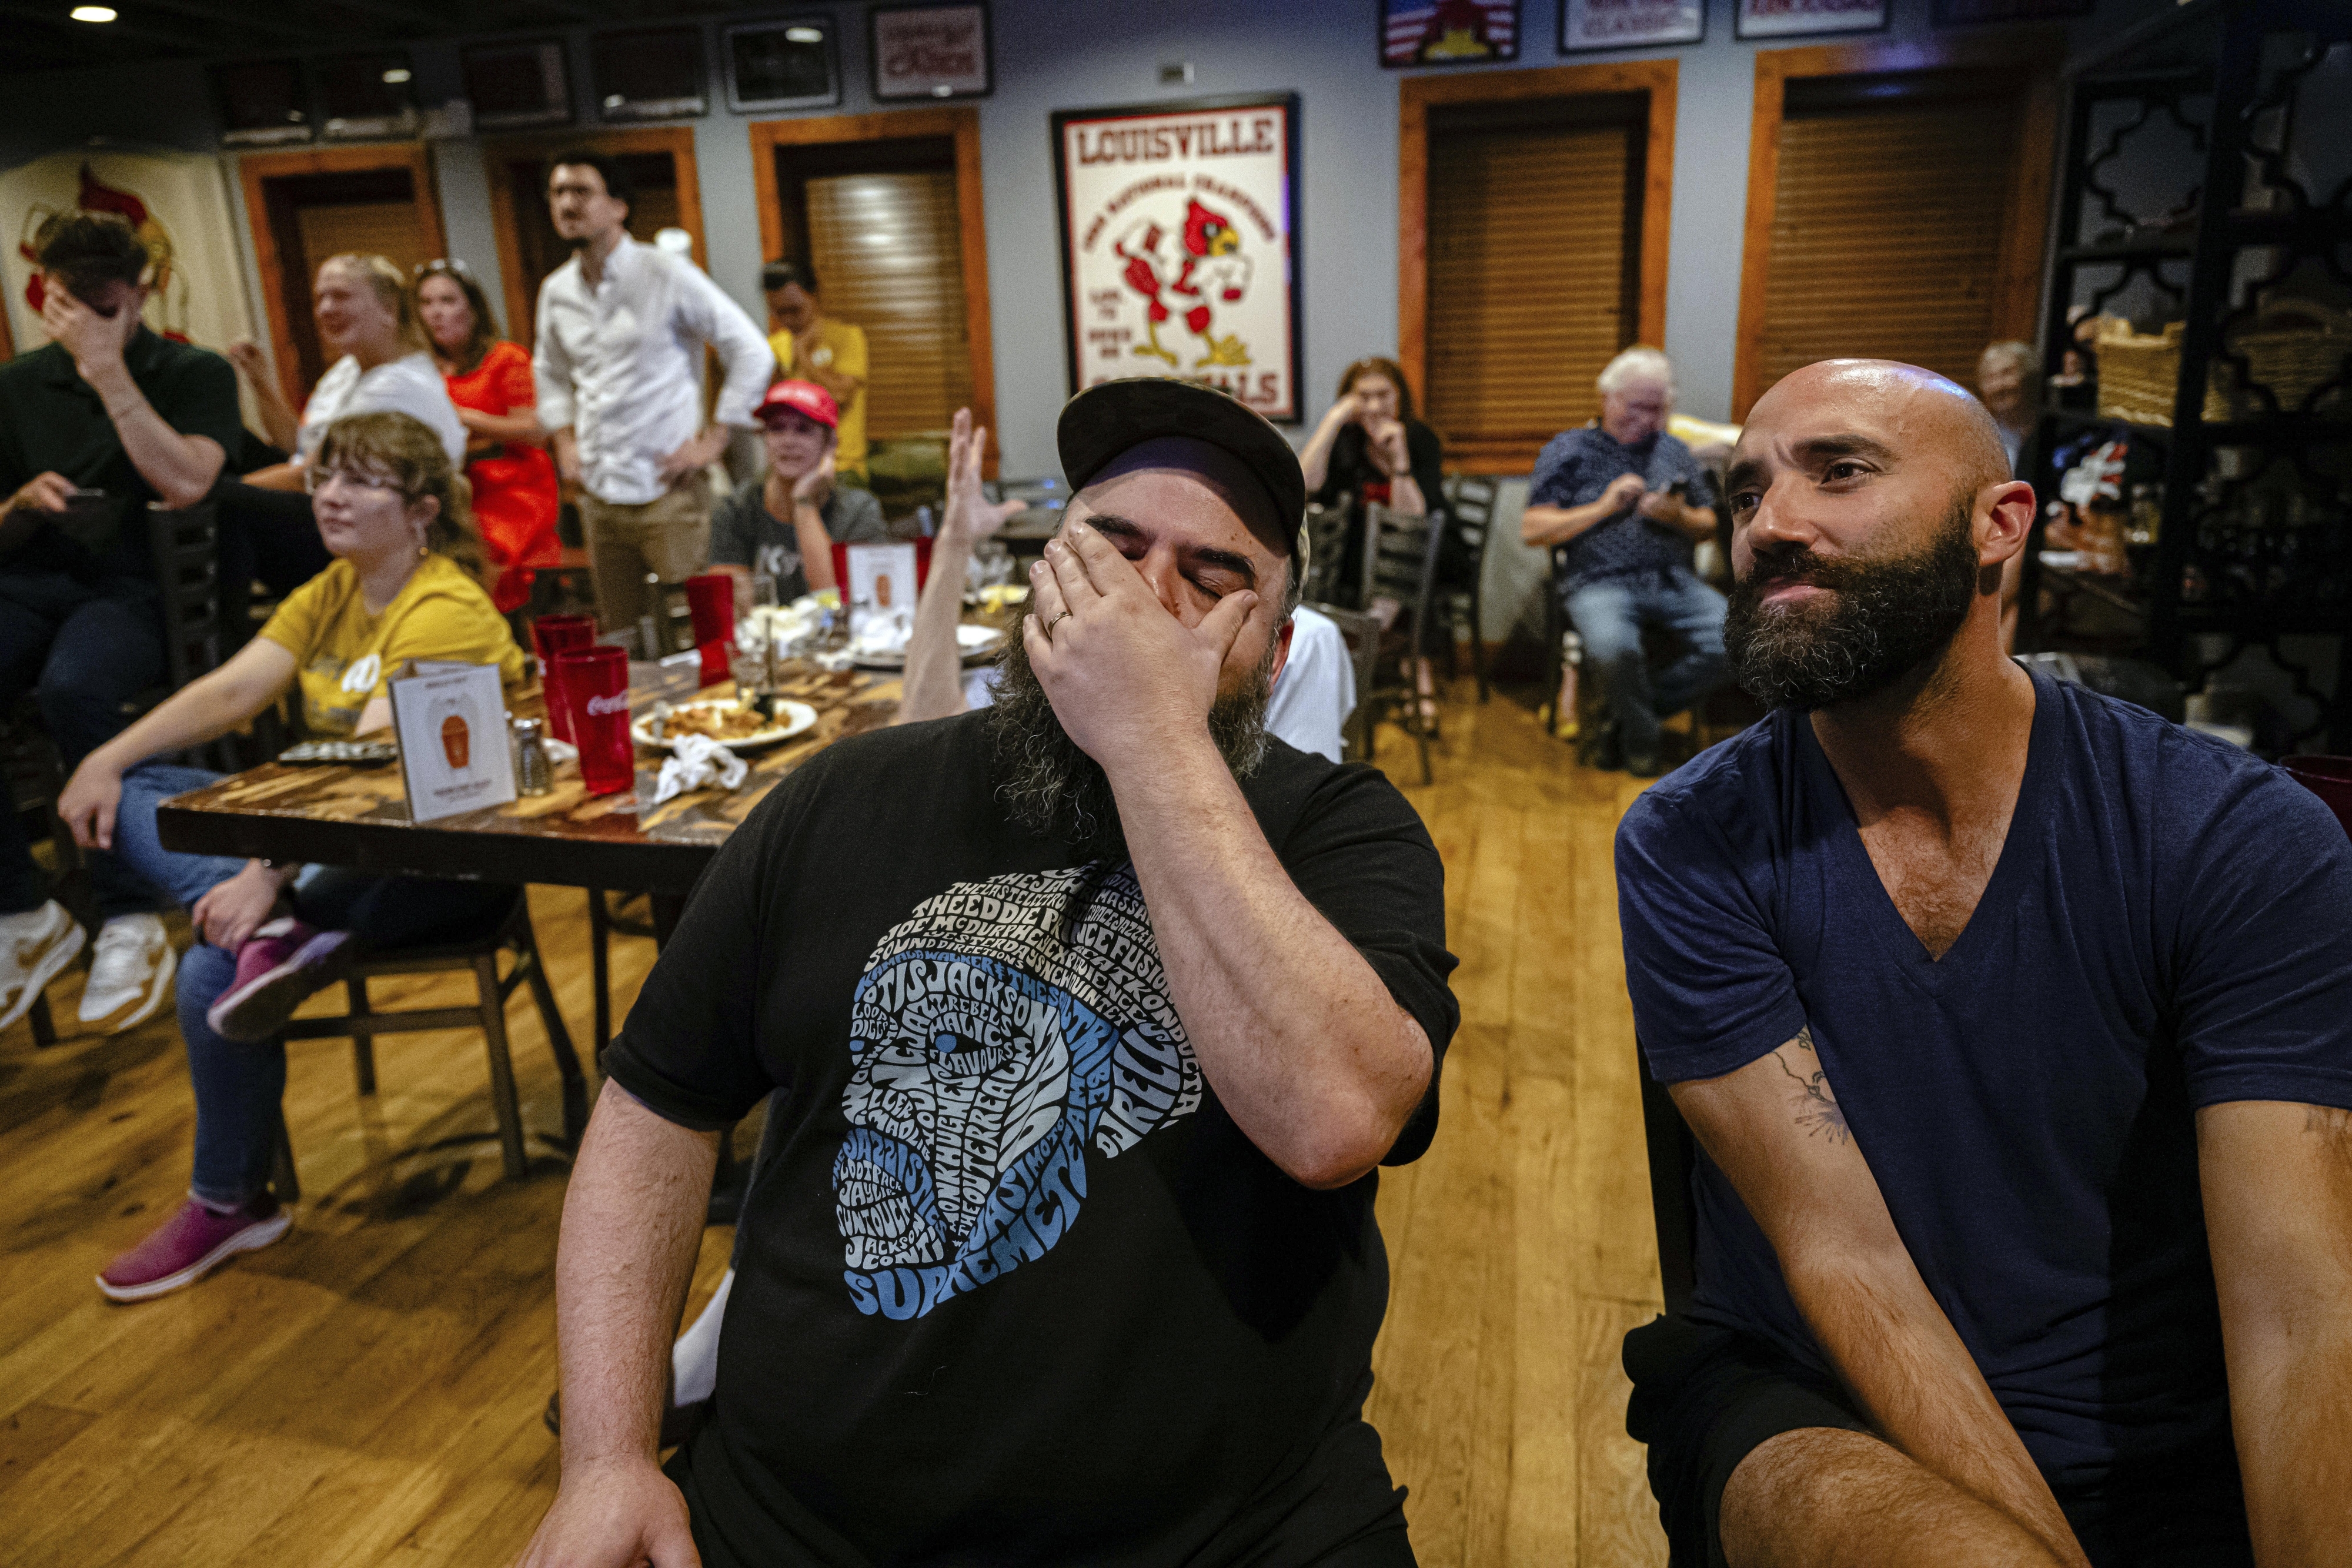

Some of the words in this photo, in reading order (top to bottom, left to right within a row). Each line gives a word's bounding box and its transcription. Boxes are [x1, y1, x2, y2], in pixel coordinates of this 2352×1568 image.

[1077, 119, 1274, 165] LOUISVILLE
[912, 894, 965, 918] THE
[963, 895, 1039, 927] EDDIE
[945, 882, 983, 895] THE
[980, 884, 1017, 901] LAST
[1014, 890, 1067, 910] ELECTRO
[1110, 916, 1145, 941] JAZZ
[986, 872, 1039, 888] THE
[1095, 888, 1151, 926] MASSA
[864, 937, 936, 972] SOUND
[937, 939, 1024, 969] DIRECTIONS
[877, 917, 928, 947] JOE
[923, 931, 1045, 972] YESTERDAYS
[854, 950, 924, 1002] KAMALA
[924, 950, 995, 977] WALKER
[1007, 967, 1051, 999] THE
[853, 1002, 888, 1021] LOOP
[863, 959, 927, 1013] OTIS
[926, 961, 1057, 1054] JACKSON
[946, 994, 1012, 1037] REBELS
[929, 1041, 1014, 1075] FLAVOURS
[868, 1109, 931, 1162] MADLIB
[930, 1062, 981, 1167] HUGHES
[840, 1158, 903, 1192] LOOTPACK
[962, 1124, 1001, 1206] OUTER
[836, 1195, 911, 1238] SUNTOUCH
[839, 1181, 897, 1207] JAYLIB
[934, 1162, 961, 1233] MONK
[845, 1212, 926, 1268] JACKSON
[957, 1203, 981, 1236] THE
[843, 1185, 1065, 1320] SUPREME
[862, 1225, 944, 1270] CONTI
